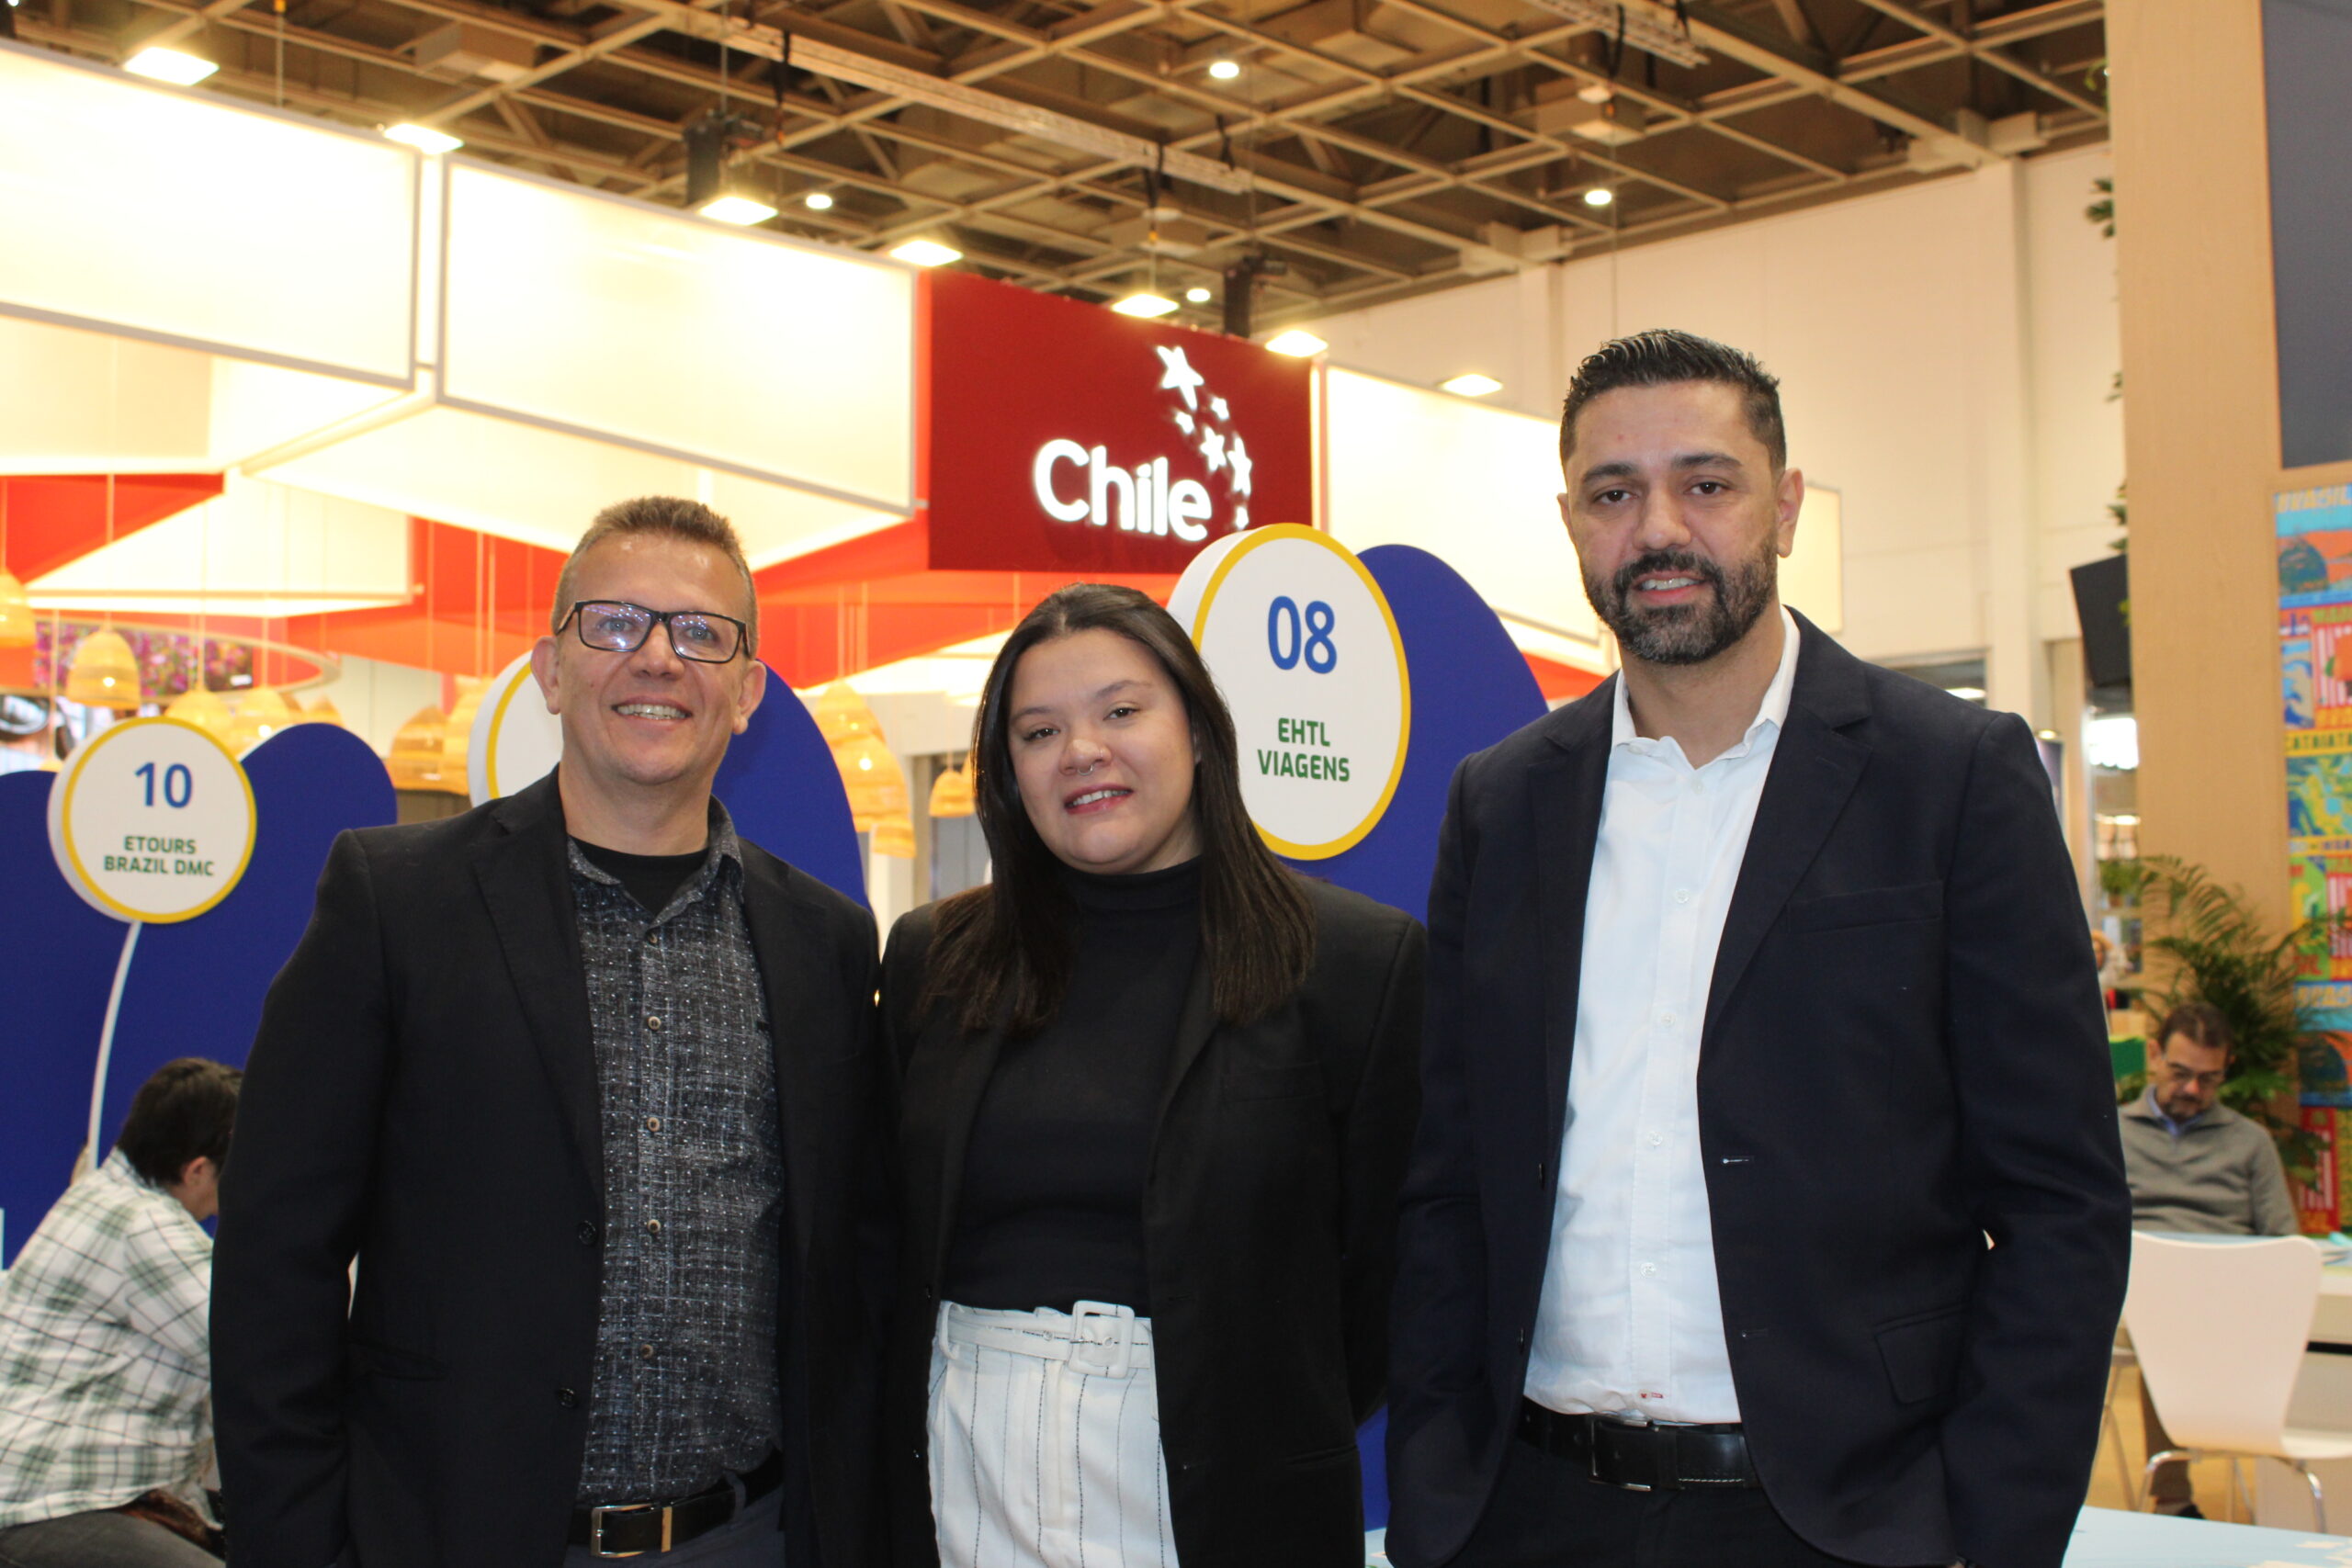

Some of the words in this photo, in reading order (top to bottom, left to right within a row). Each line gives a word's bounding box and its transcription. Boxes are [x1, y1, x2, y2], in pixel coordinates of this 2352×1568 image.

[1034, 438, 1213, 541] Chile
[1267, 595, 1338, 674] 08
[1277, 717, 1331, 748] EHTL
[1257, 749, 1351, 783] VIAGENS
[134, 761, 193, 809] 10
[123, 835, 197, 855] ETOURS
[103, 855, 169, 874] BRAZIL
[174, 859, 216, 877] DMC
